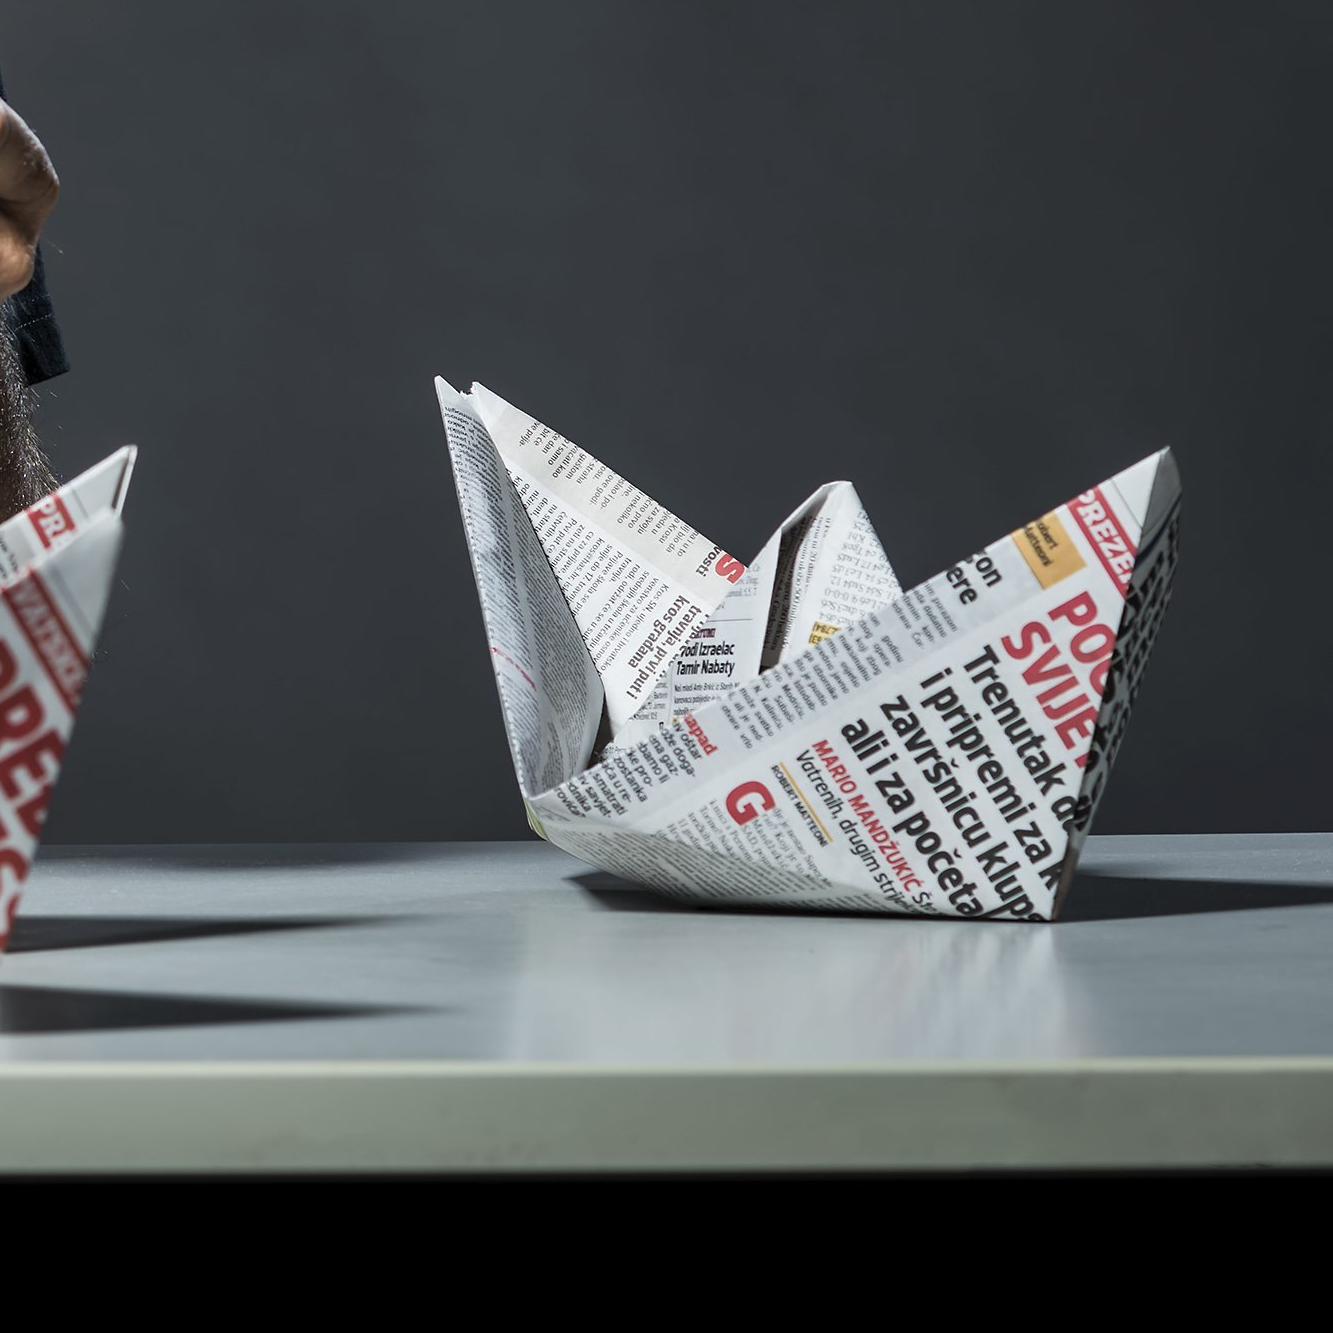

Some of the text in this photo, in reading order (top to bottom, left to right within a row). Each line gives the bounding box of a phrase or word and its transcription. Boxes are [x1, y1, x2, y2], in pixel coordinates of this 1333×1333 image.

[566, 453, 586, 479] guštom
[575, 462, 594, 484] straha
[587, 550, 623, 595] Prijave škola
[609, 555, 631, 583] travnja.
[715, 552, 747, 585] S
[589, 571, 648, 648] srednjih škola trčanju
[608, 580, 627, 603] održat
[608, 577, 657, 640] venstvo učenike
[600, 583, 669, 670] Kros ujedno hrvatsko
[628, 595, 689, 671] kros građana
[630, 600, 701, 692] travnja, prvi put
[698, 641, 734, 656] Izraelac
[676, 659, 734, 676] Tamir Nabaty
[1004, 624, 1101, 769] SVIJE
[841, 715, 888, 759] ali
[966, 647, 1064, 792] Trenutak
[680, 733, 701, 759] oštar
[866, 753, 898, 774] i
[920, 667, 1051, 863] i pripremi za
[876, 772, 914, 813] za
[882, 697, 985, 843] završnicu
[593, 773, 625, 814] smatrati
[724, 779, 774, 824] G
[771, 765, 827, 846] ROBERT MATTEONI
[797, 750, 881, 871] Vatrenih, drugim
[813, 740, 920, 890] MARIO MANDŽUKIĆ
